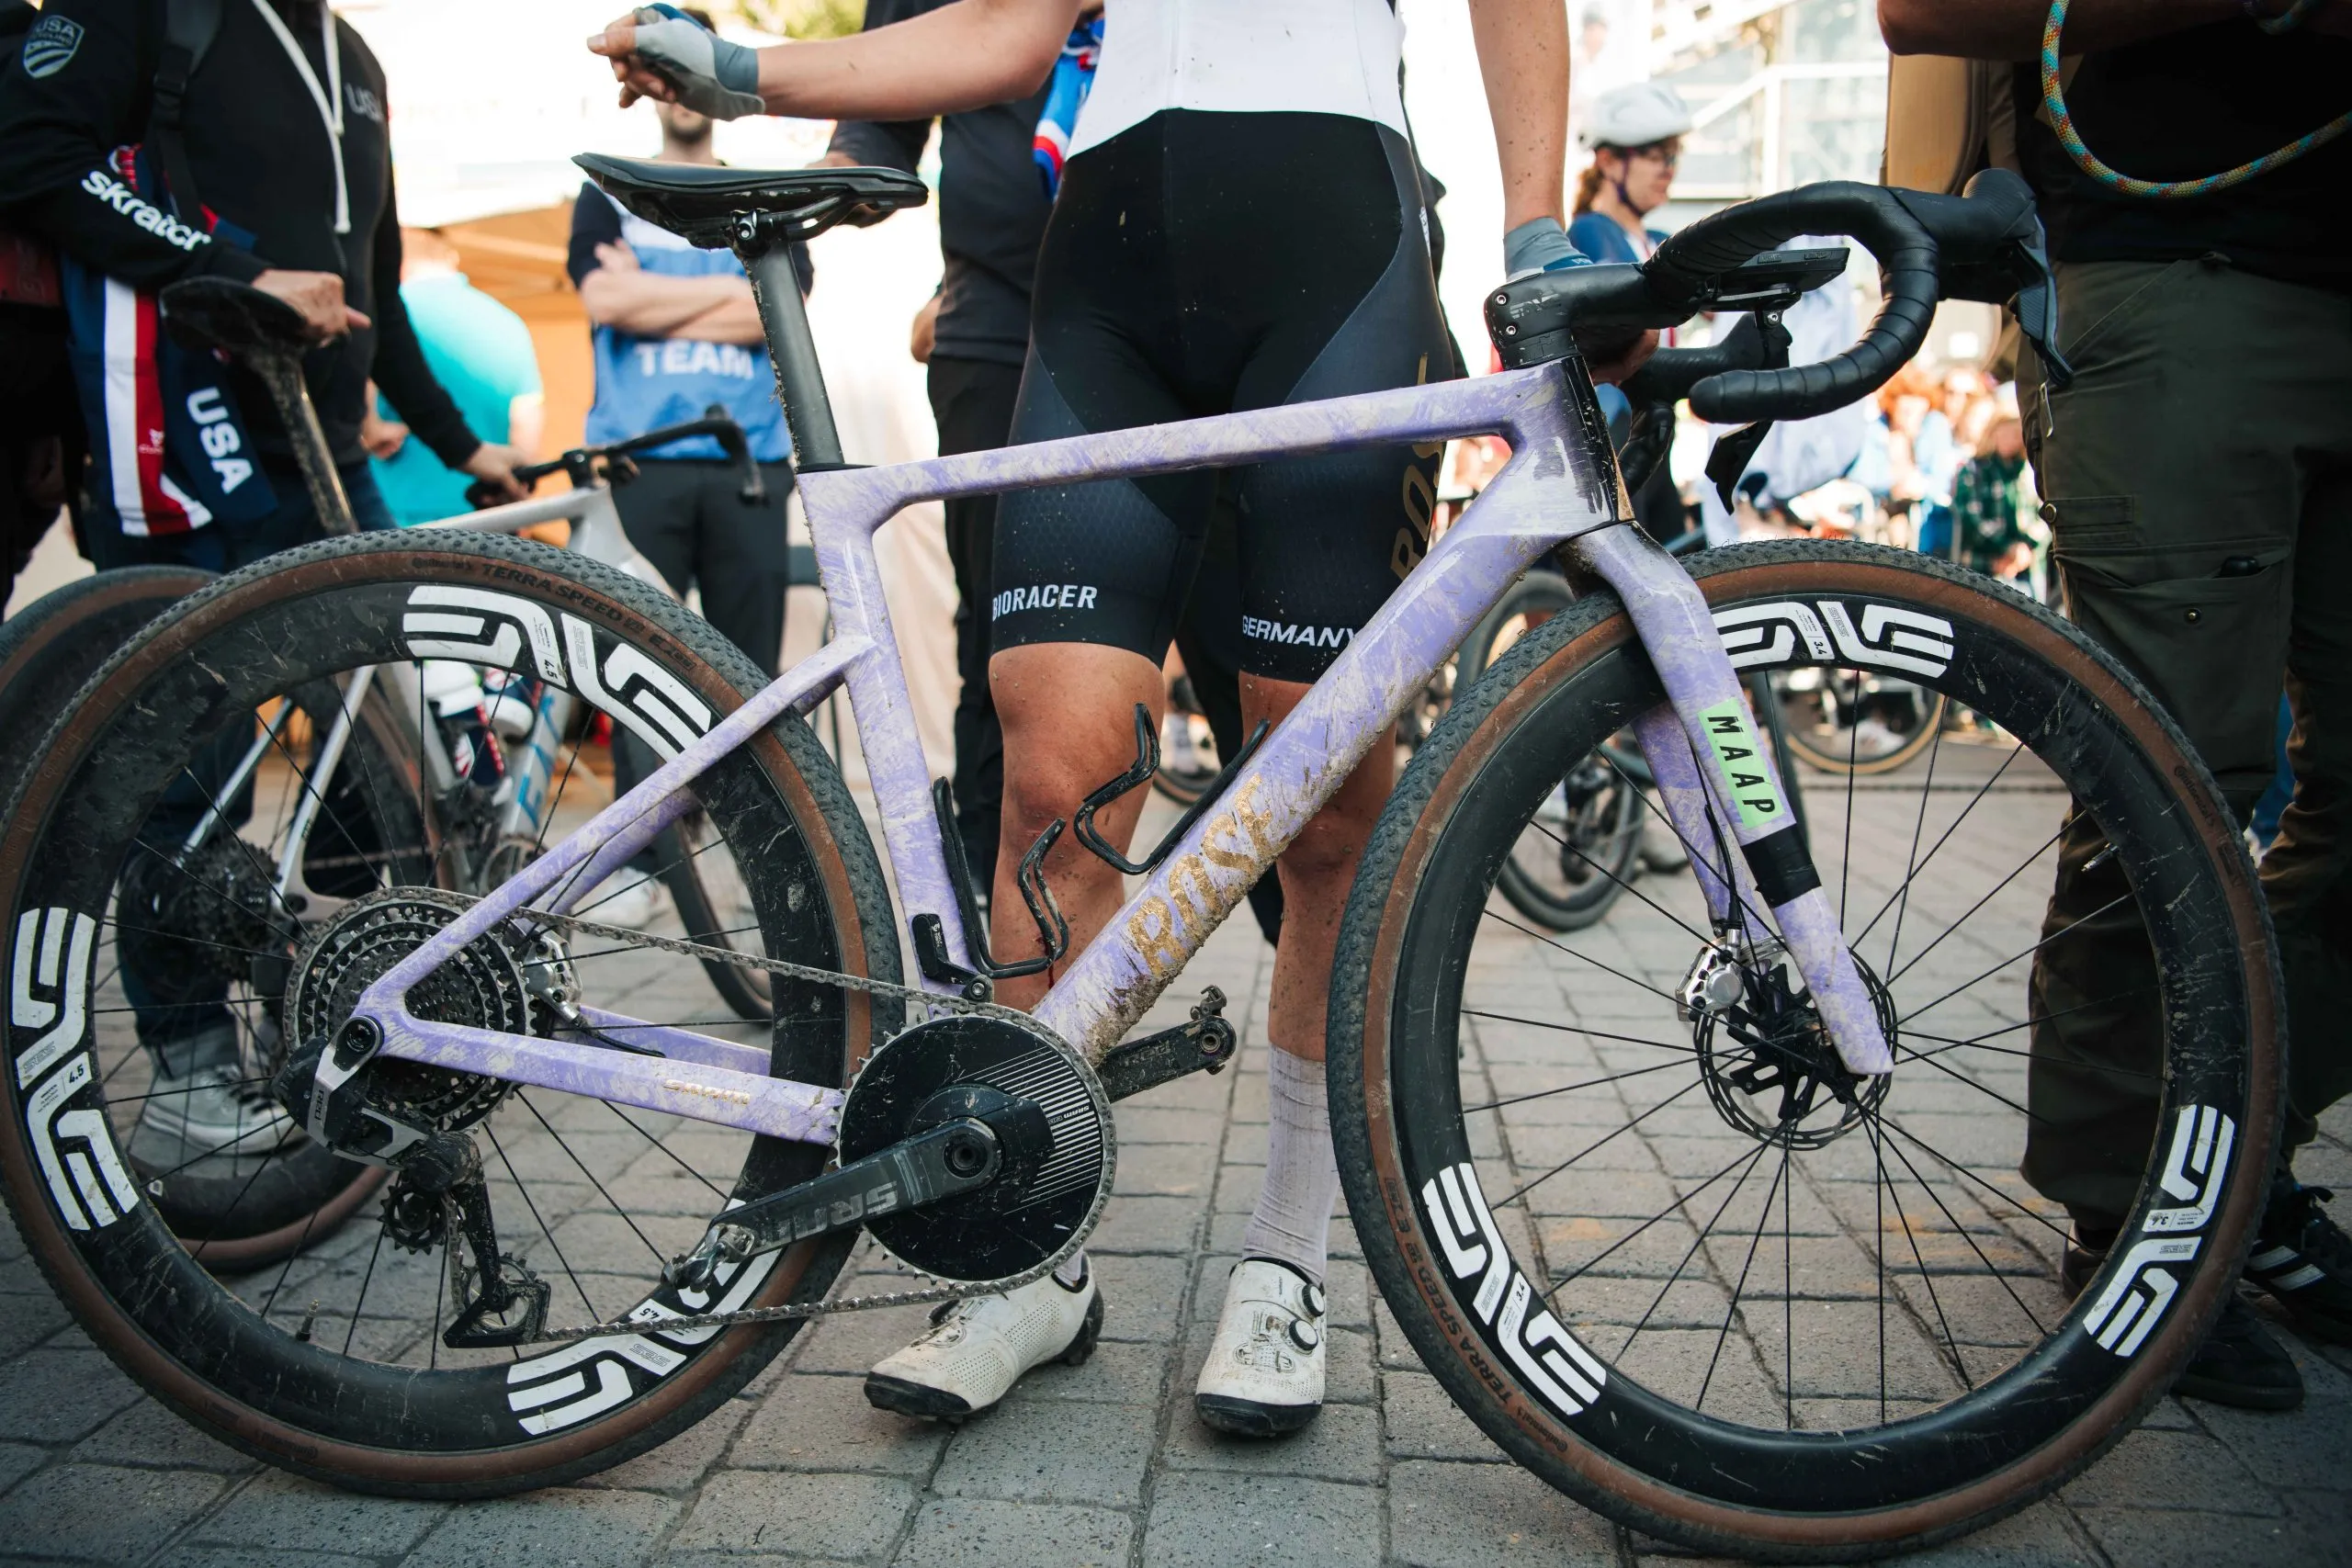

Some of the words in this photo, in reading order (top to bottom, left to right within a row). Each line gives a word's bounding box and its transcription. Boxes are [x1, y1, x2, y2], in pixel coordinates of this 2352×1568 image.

[634, 339, 754, 380] TEAM
[187, 386, 254, 494] USA
[481, 563, 552, 592] TERRA
[555, 584, 623, 623] SPEED
[992, 584, 1098, 622] BIORACER
[544, 659, 559, 679] 4.5
[1814, 640, 1827, 655] 3.4
[1707, 716, 1775, 813] MAAP
[1128, 773, 1274, 976] ROSE
[12, 907, 140, 1231] ENVE
[69, 1063, 85, 1084] 4.5
[1419, 1267, 1464, 1337] SPEED
[1421, 1163, 1607, 1416] ENVE
[1460, 1338, 1513, 1404] TERRA
